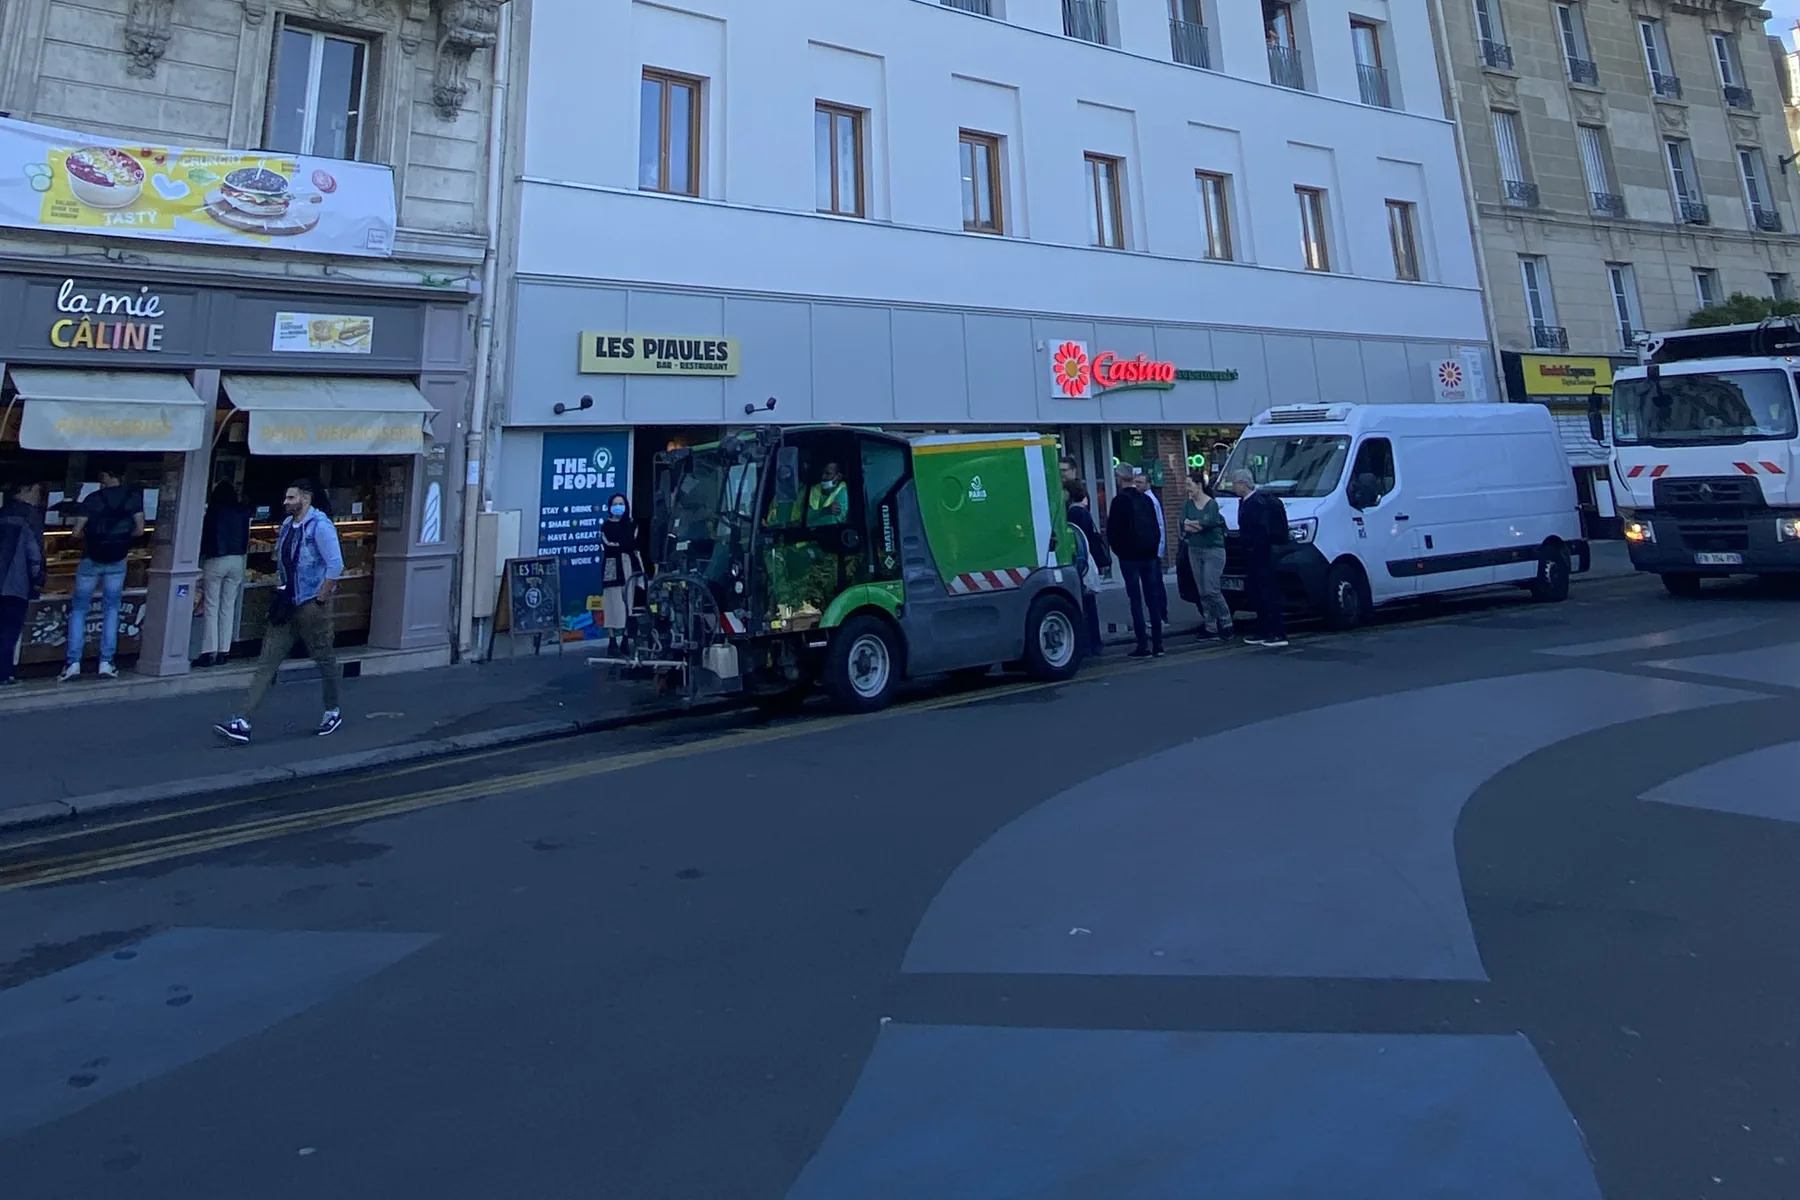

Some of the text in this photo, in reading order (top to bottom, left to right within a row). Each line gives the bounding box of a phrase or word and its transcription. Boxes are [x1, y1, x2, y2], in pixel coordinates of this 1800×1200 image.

[104, 210, 158, 226] TASTY
[57, 278, 165, 318] la mie
[50, 314, 164, 351] CÂLINE
[596, 337, 728, 361] LES PIAULES
[656, 361, 672, 369] BAR
[680, 362, 728, 371] RESTAURANT
[1092, 352, 1176, 388] Casino
[553, 458, 587, 474] THE
[552, 472, 616, 490] PEOPLE
[968, 489, 987, 499] PARIS
[542, 506, 559, 515] STAY
[571, 505, 592, 513] DRINK
[548, 518, 597, 529] SHARE MEET
[882, 504, 893, 552] MATHIEU
[547, 533, 567, 542] HAVE
[575, 531, 598, 540] GREAT
[538, 547, 562, 556] ENJOY
[563, 545, 577, 554] THE
[578, 544, 600, 553] GOOD
[571, 557, 592, 566] WORK
